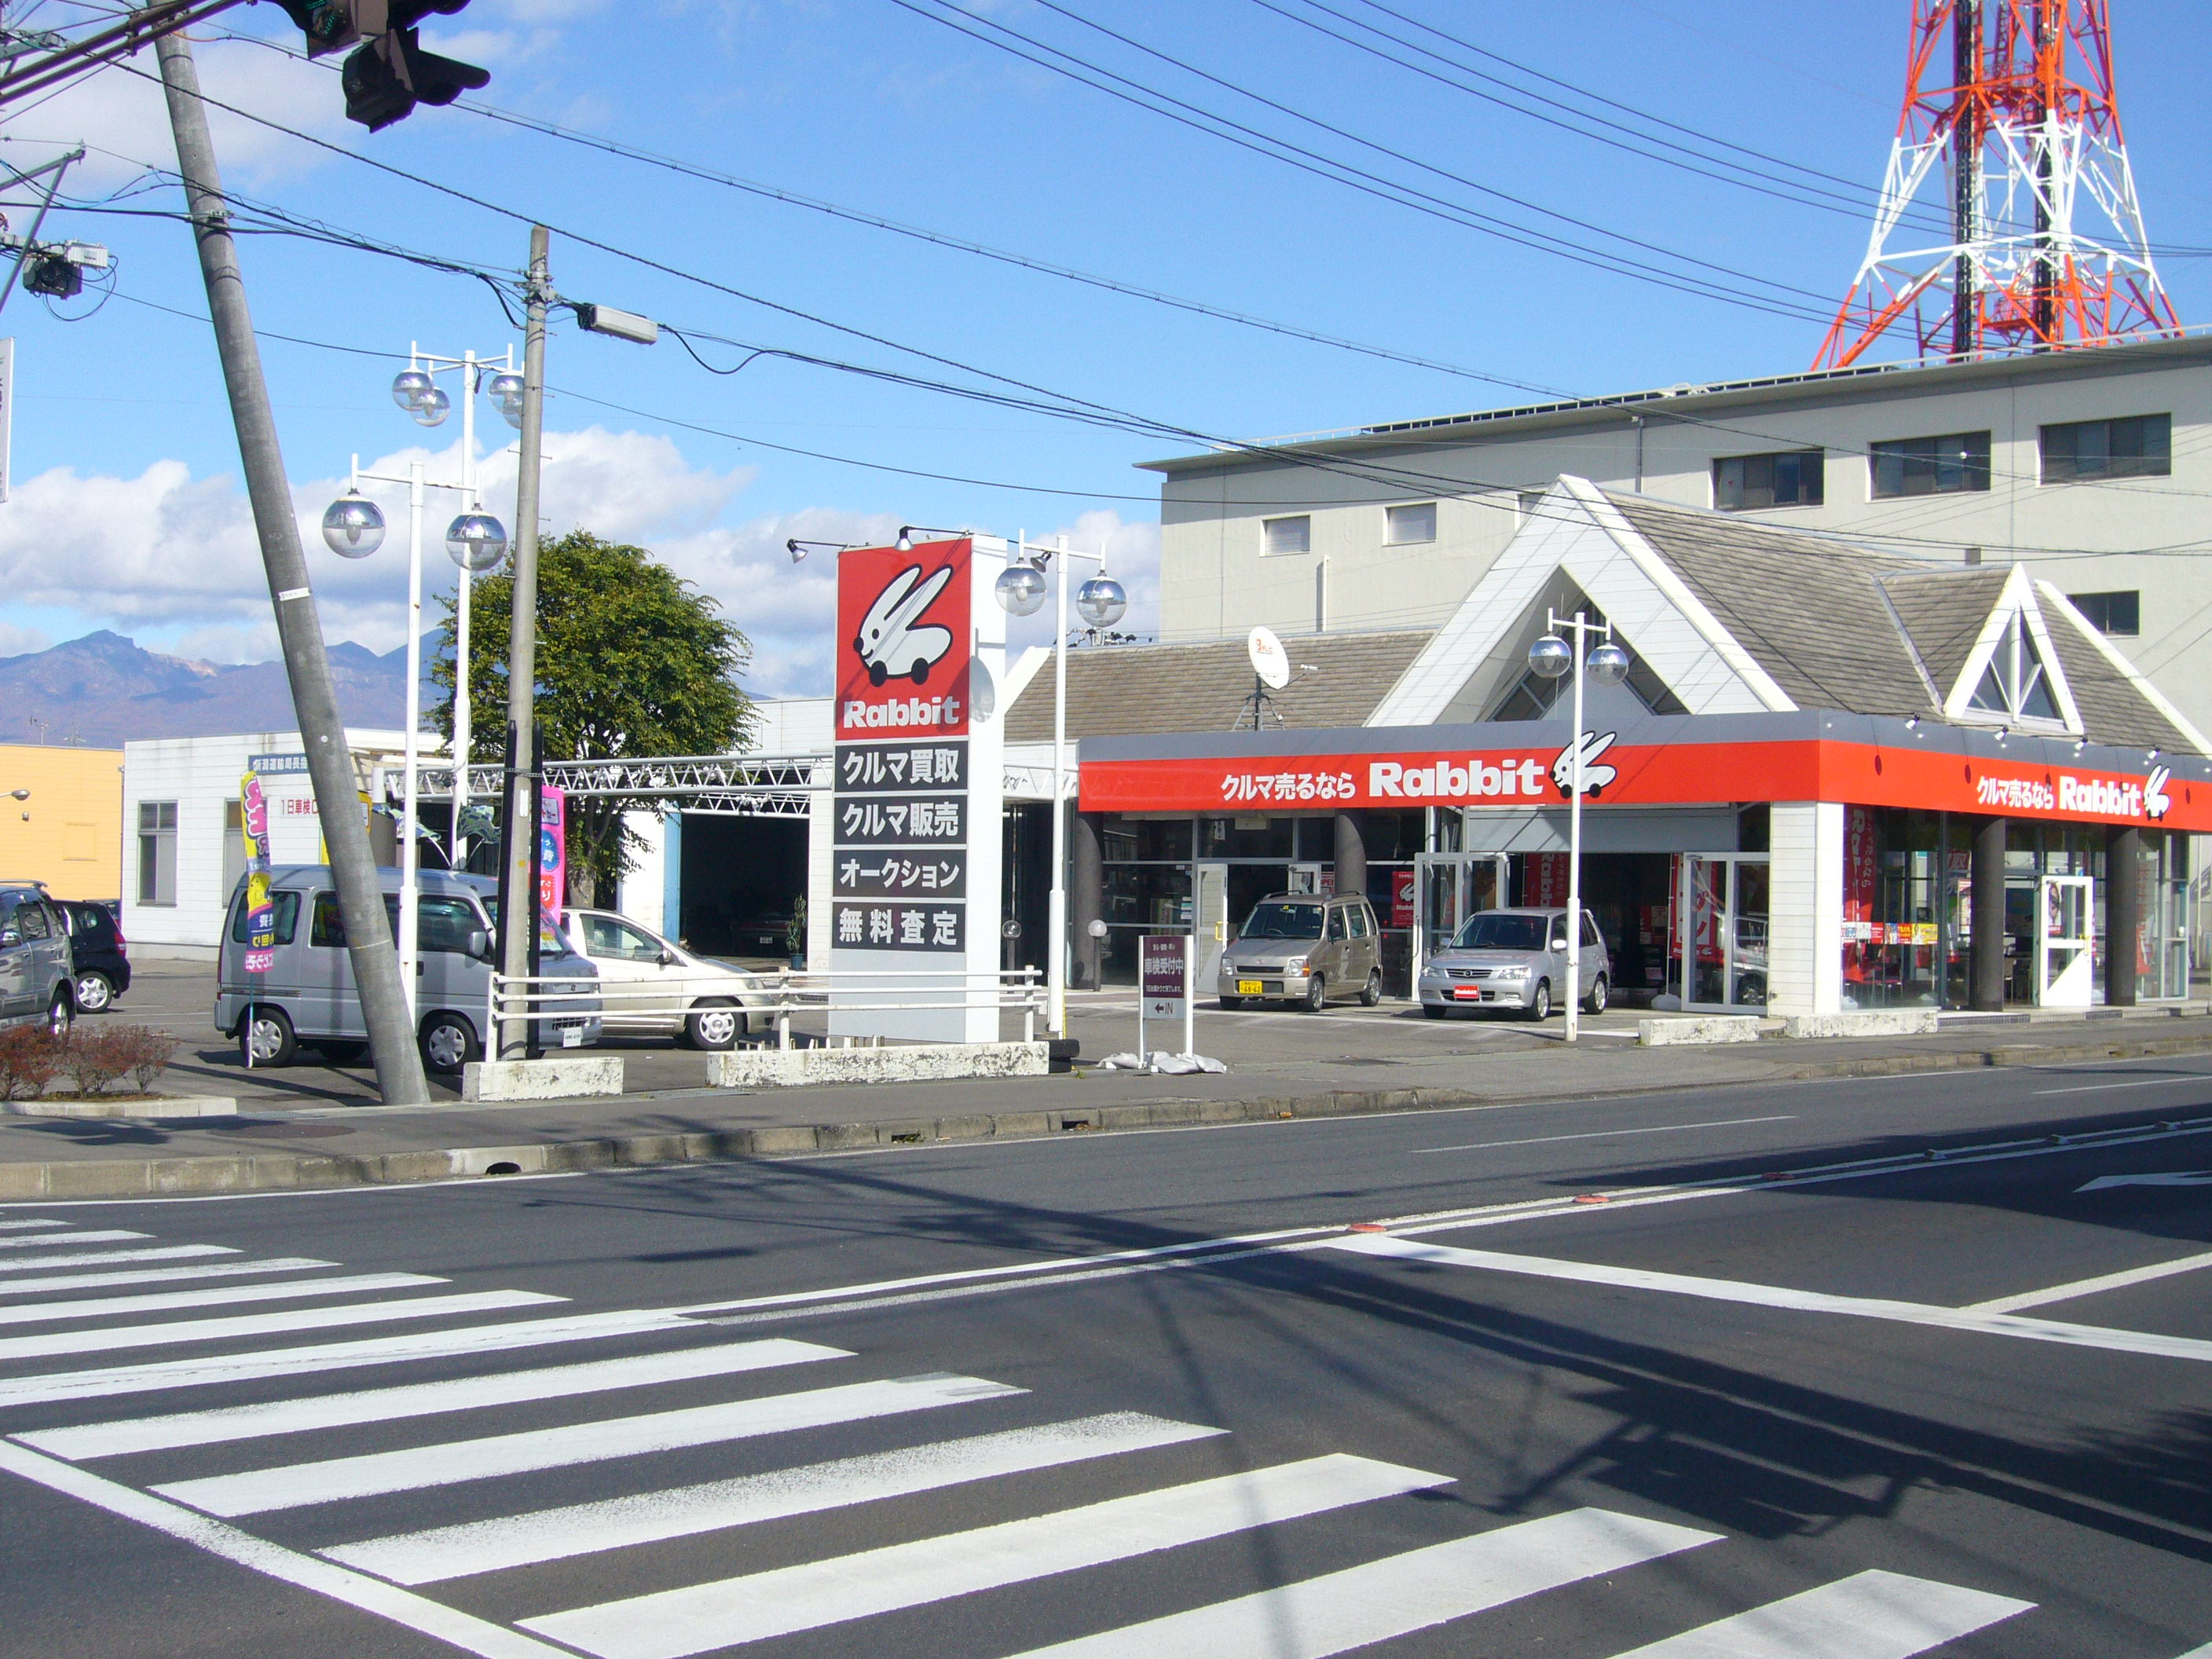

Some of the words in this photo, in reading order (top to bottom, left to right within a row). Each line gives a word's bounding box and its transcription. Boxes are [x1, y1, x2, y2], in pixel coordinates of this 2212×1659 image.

[843, 696, 960, 728] Rabbit
[842, 749, 959, 785] クルマ買取
[1220, 772, 1356, 801] クルマ売るなら
[1369, 758, 1544, 797] Rabbit
[1976, 775, 2055, 810] クルマ売るなら
[2059, 775, 2143, 817] Rabbit
[842, 801, 959, 837] クルマ販売
[840, 858, 960, 889] オークション
[838, 907, 958, 946] 無料査定
[1144, 956, 1184, 976] 車検受付中
[1164, 1002, 1174, 1015] IN
